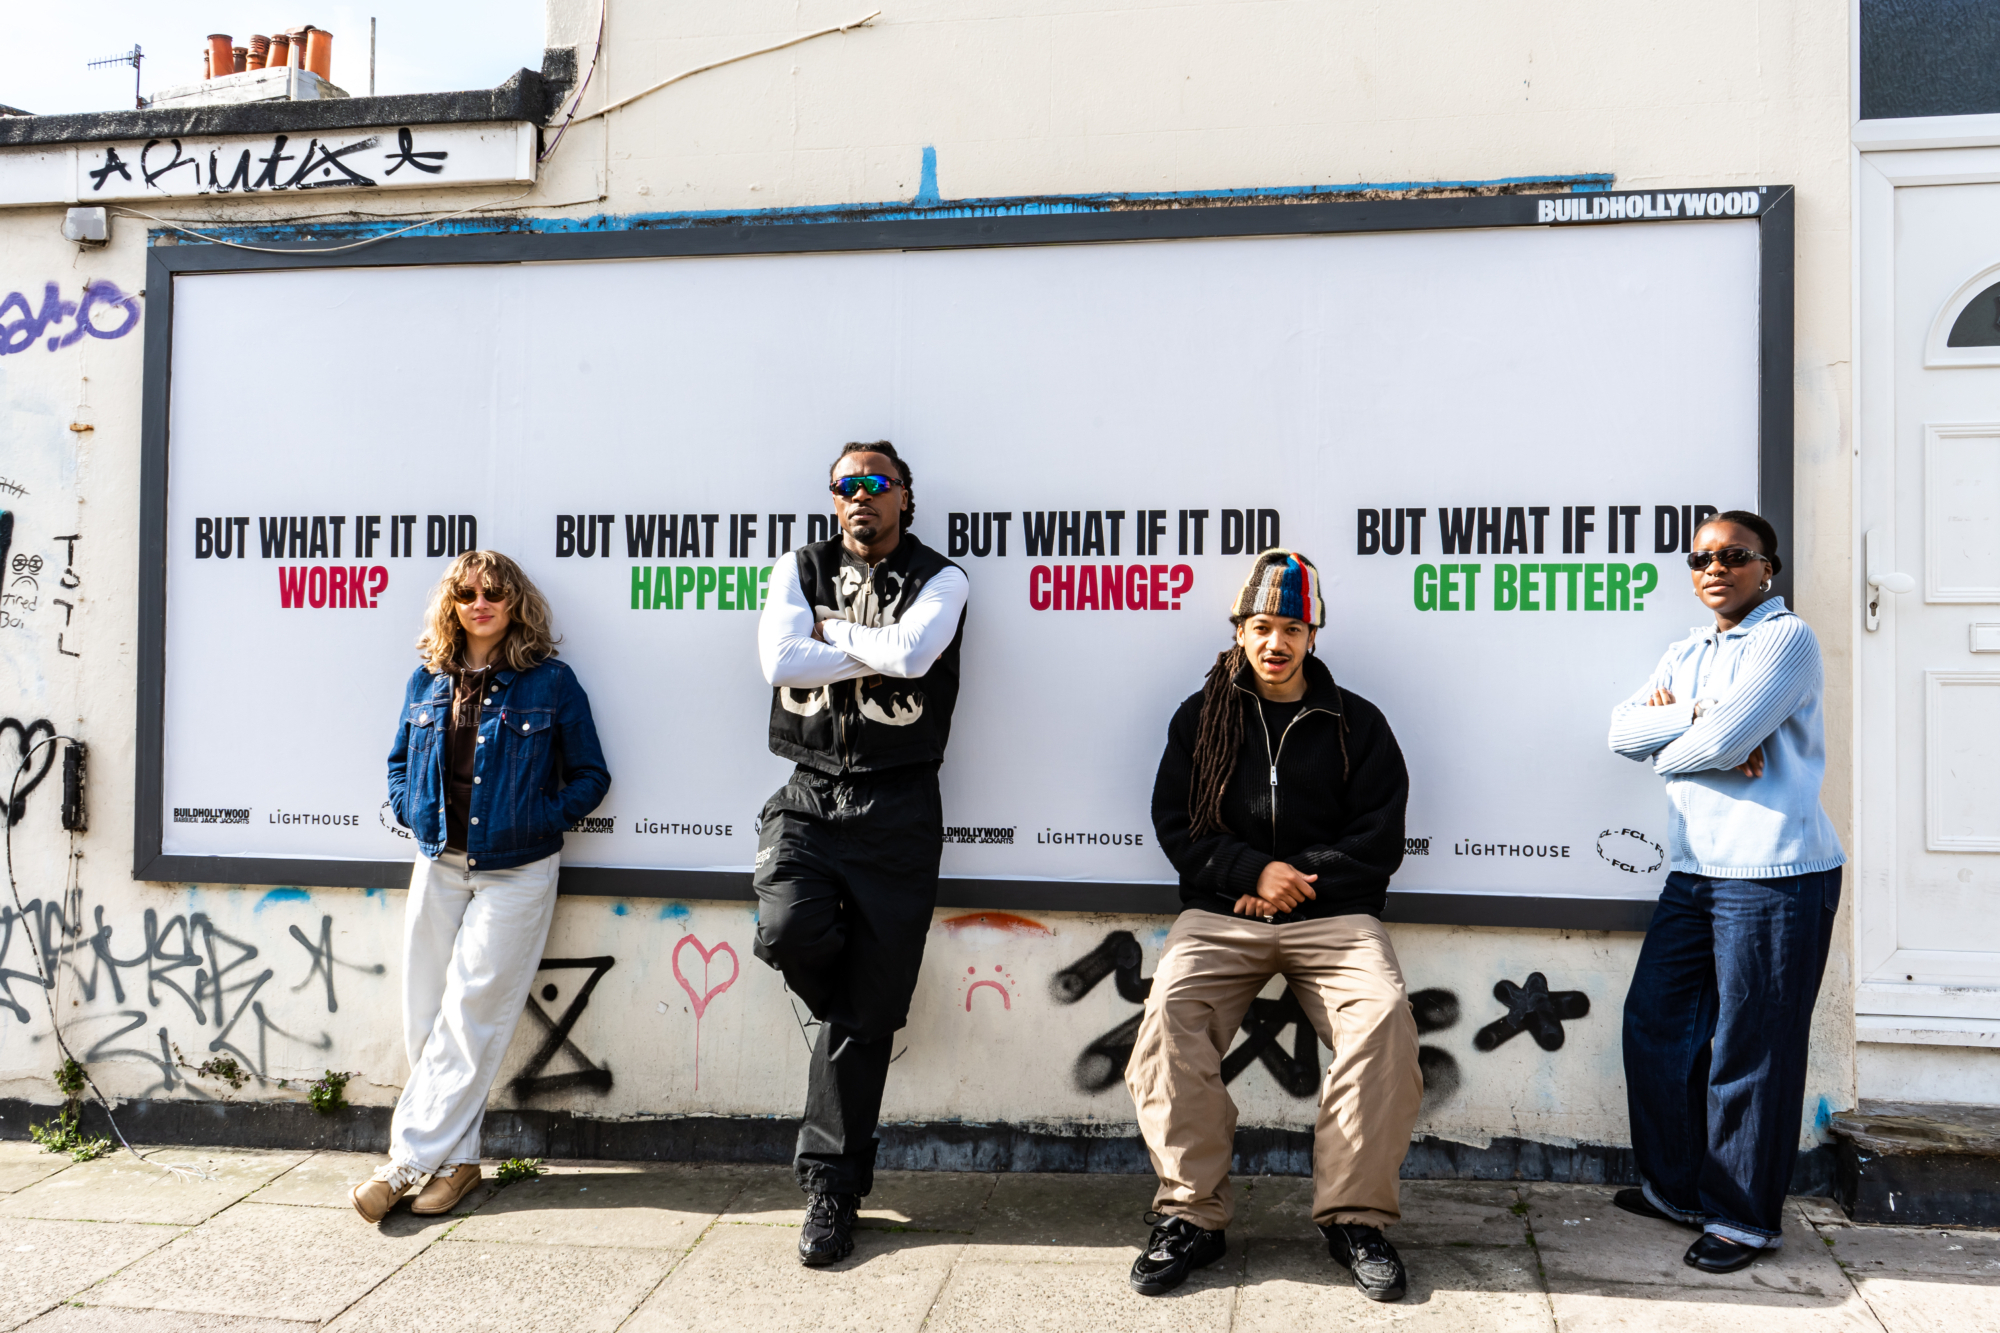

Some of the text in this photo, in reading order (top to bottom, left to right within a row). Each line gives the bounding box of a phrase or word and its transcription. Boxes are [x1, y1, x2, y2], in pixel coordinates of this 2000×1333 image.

[1538, 191, 1760, 223] BUILDHOLLYWOOD
[196, 515, 477, 559] BUT WHAT IF IT DID
[556, 515, 614, 558] BUT
[625, 514, 719, 558] WHAT
[730, 514, 757, 558] IF
[768, 514, 796, 558] IT
[948, 509, 1280, 557] BUT WHAT IF IT DID
[1357, 508, 1426, 555] BUT
[1439, 507, 1549, 554] WHAT
[1563, 506, 1594, 554] IF
[1608, 506, 1641, 553] IT
[279, 566, 388, 608] WORK?
[1030, 564, 1193, 610] CHANGE?
[1414, 563, 1658, 611] GET BETTER?
[174, 808, 250, 818] BUILDHOLLYWOOD
